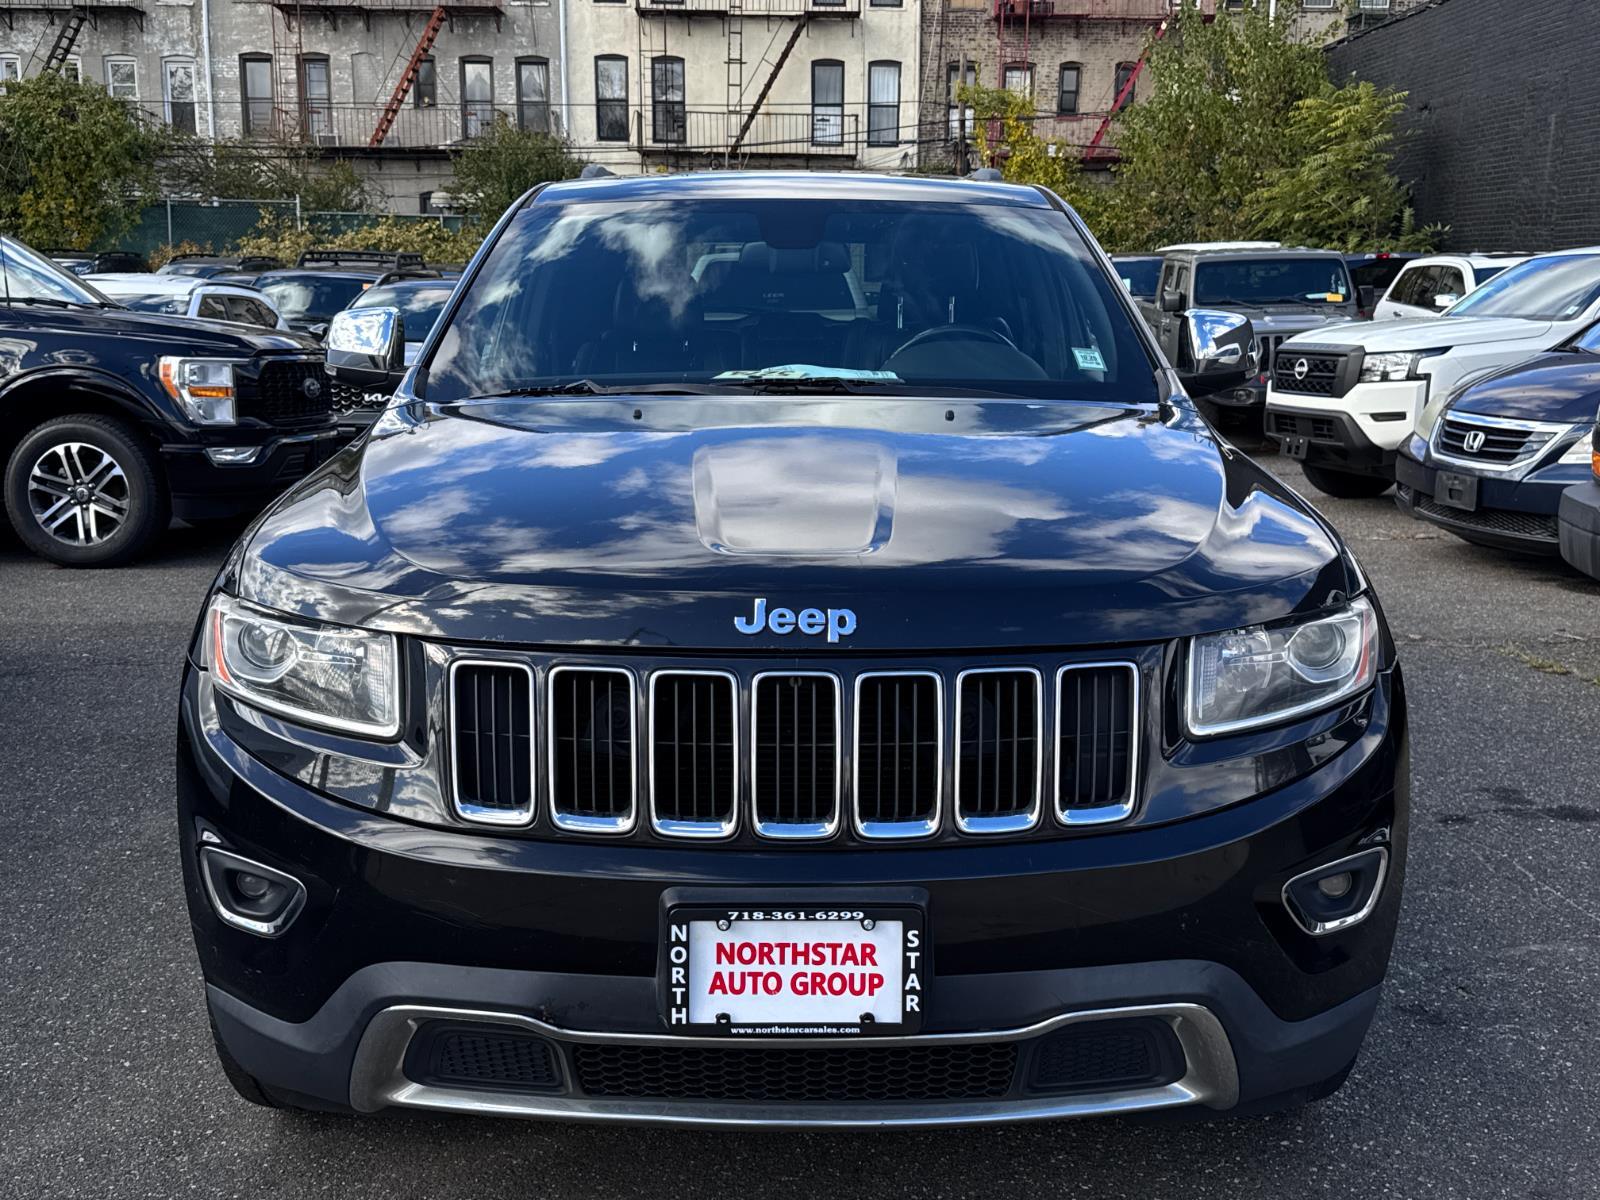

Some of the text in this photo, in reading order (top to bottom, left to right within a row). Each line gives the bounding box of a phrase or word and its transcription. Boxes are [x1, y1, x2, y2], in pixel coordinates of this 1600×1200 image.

[734, 598, 857, 643] Jeep
[728, 911, 865, 920] 718-361-6299
[715, 942, 878, 967] NORTHSTAR
[670, 924, 687, 1025] NORTH
[904, 929, 921, 1012] STAR
[708, 971, 884, 997] AUTO GROUP
[730, 1025, 861, 1034] www.northstarcarsales.com
